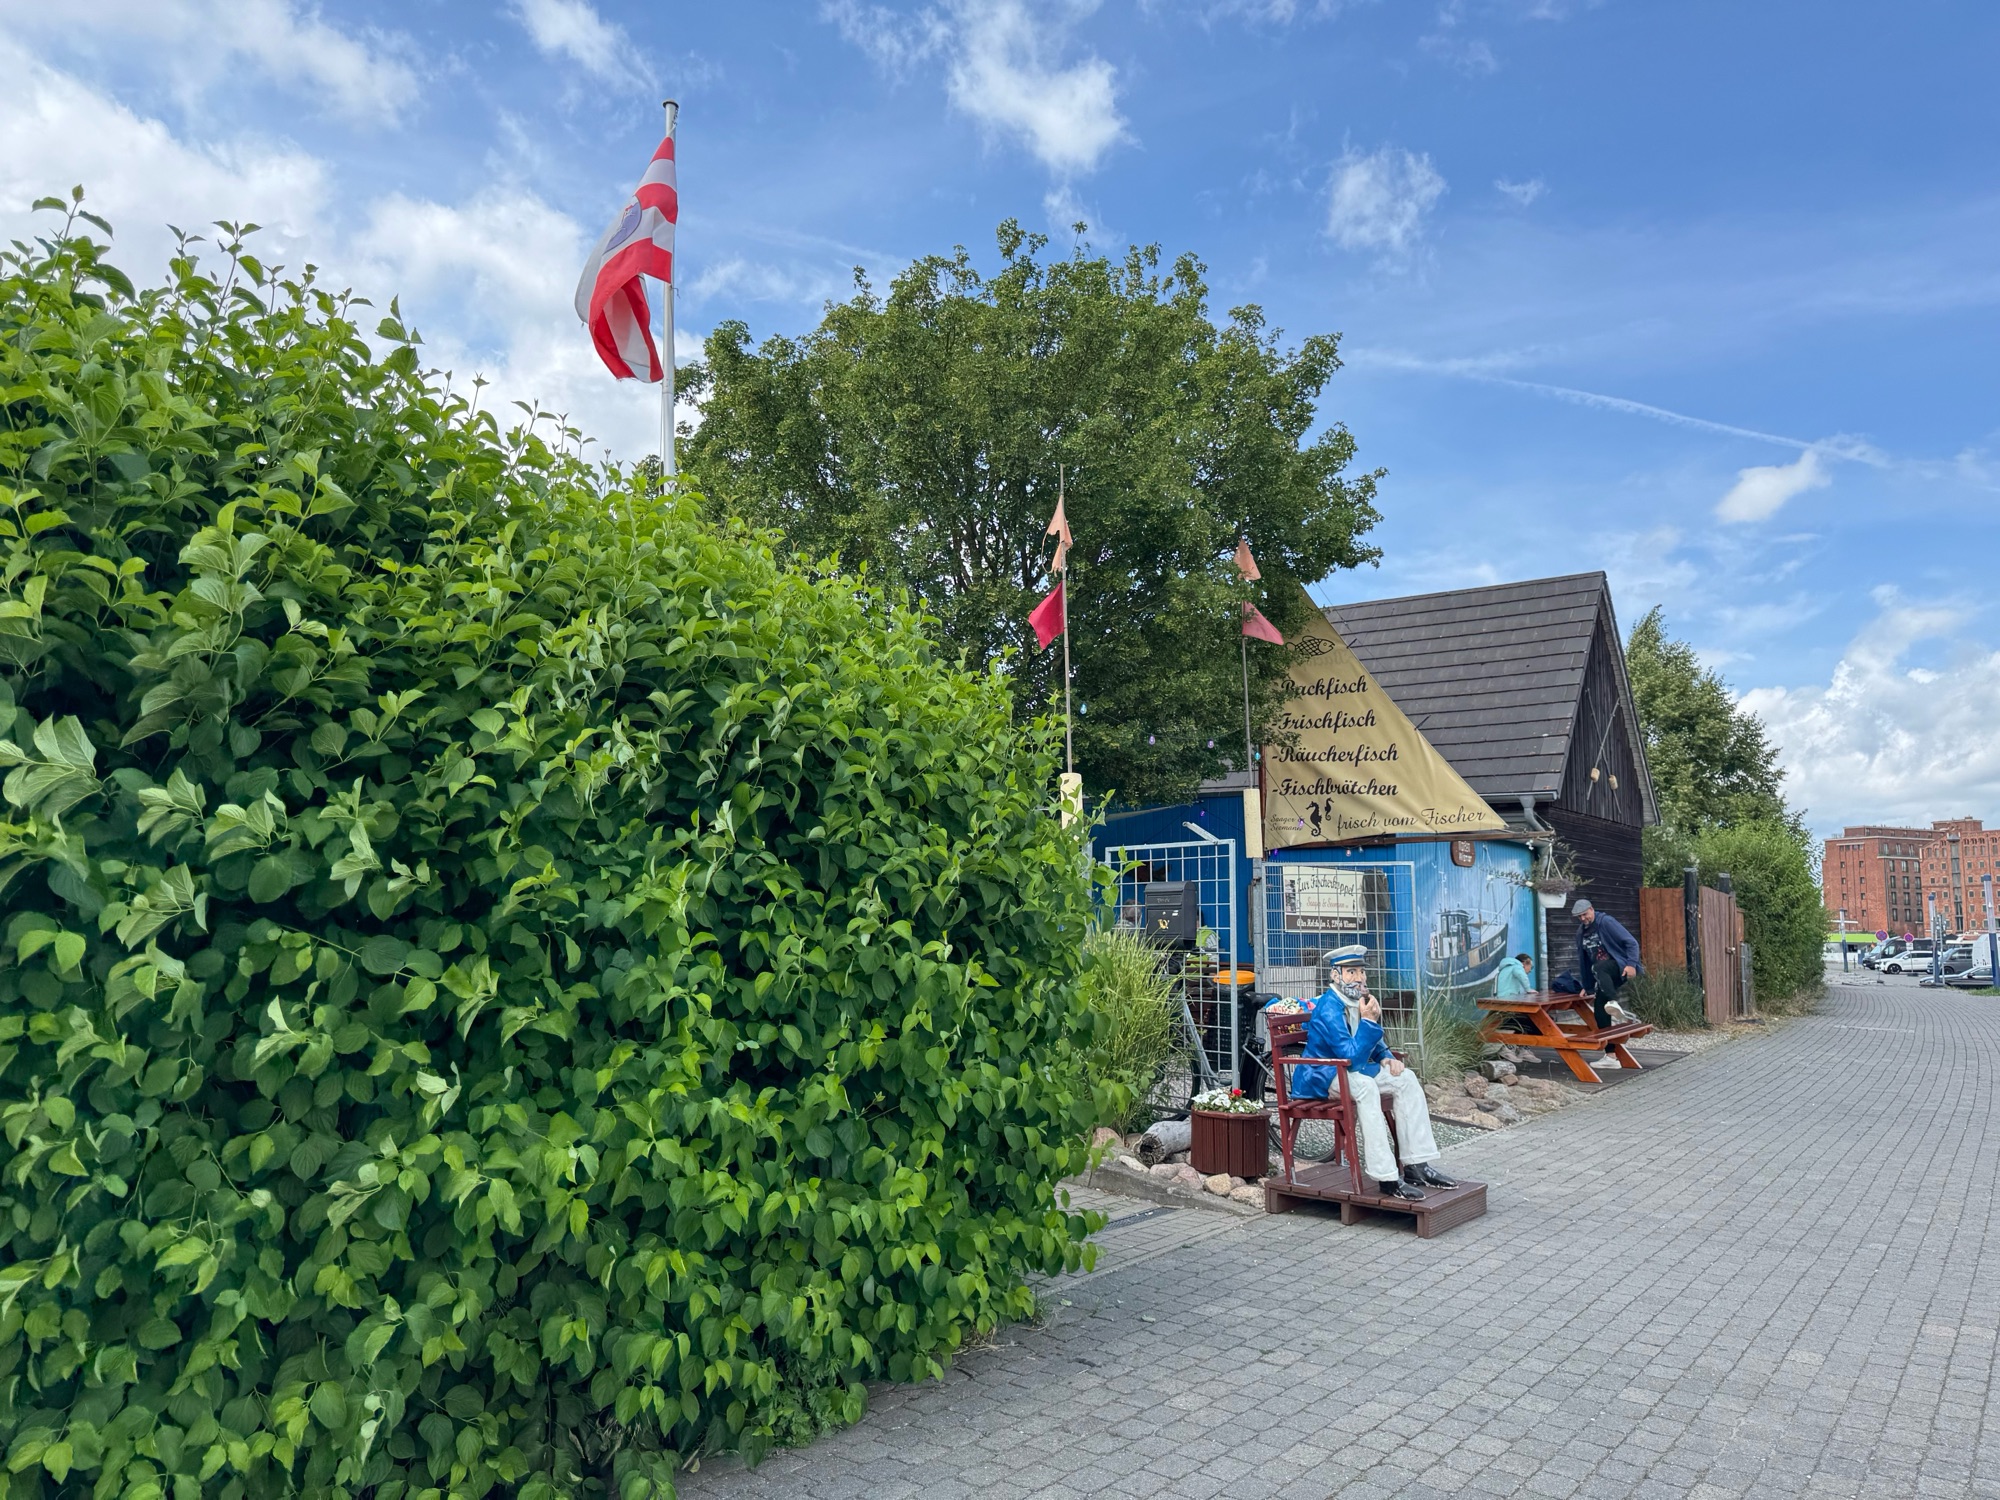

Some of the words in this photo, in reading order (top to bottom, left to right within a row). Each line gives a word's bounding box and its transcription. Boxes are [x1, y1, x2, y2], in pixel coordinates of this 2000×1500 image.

[1272, 743, 1399, 768] -Räucherfisch
[1272, 777, 1399, 796] -Fischbrötchen
[1337, 812, 1380, 836] frisch
[1383, 815, 1418, 827] vom
[1421, 805, 1486, 826] Fischer
